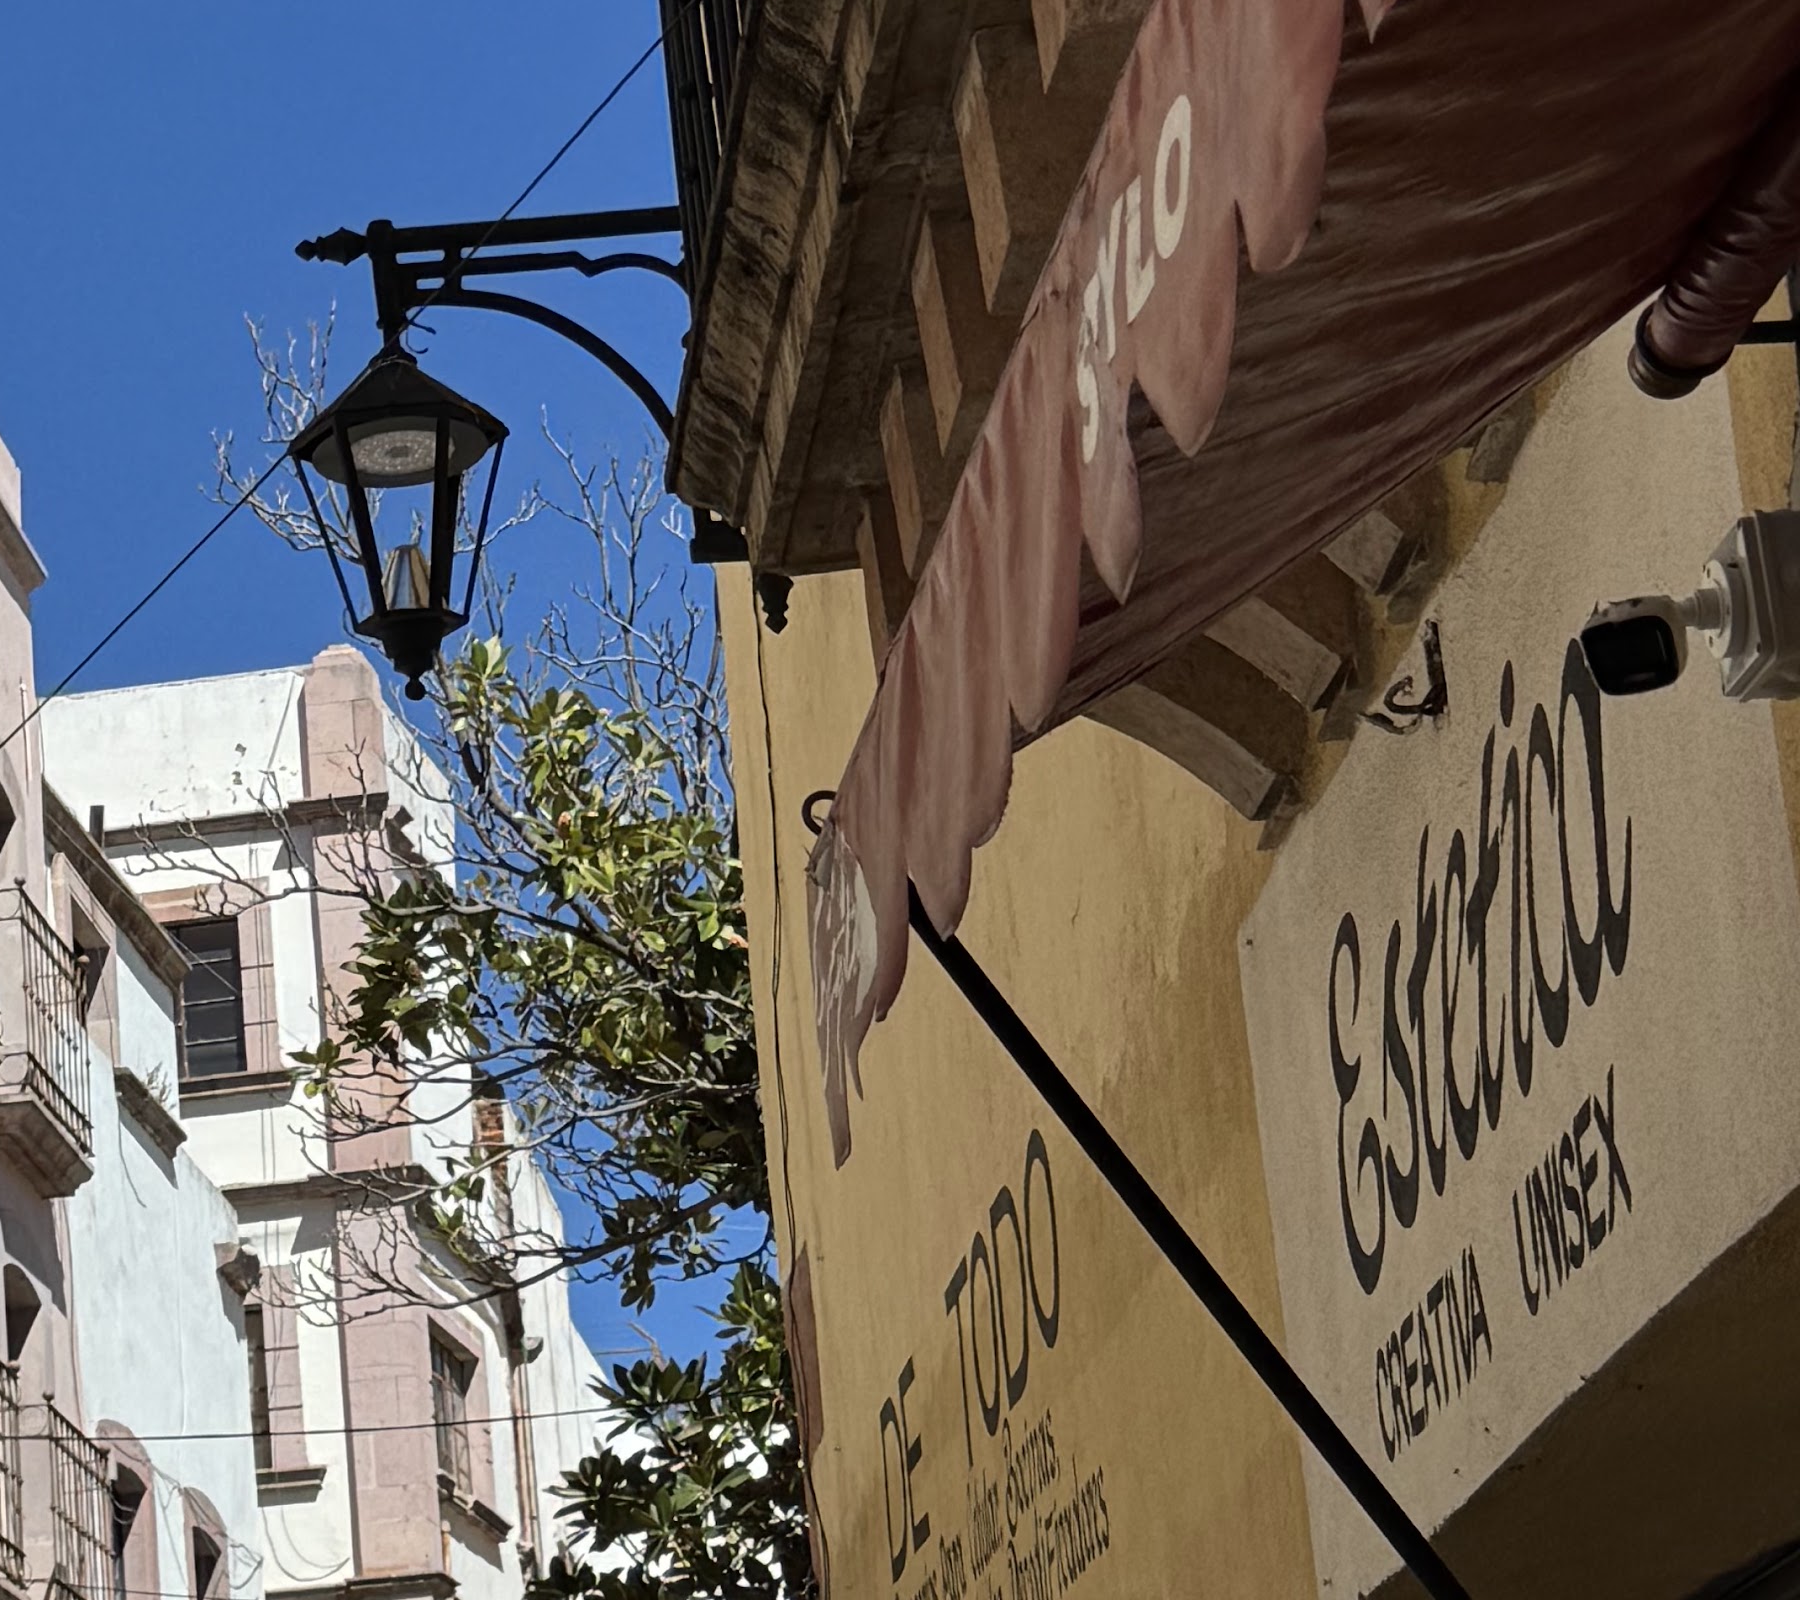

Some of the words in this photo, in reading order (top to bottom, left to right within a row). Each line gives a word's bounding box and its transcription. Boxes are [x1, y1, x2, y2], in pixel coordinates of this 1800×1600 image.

[879, 1357, 931, 1584] DE
[945, 1129, 1059, 1466] TODO
[1374, 1245, 1492, 1460] CREATIVA
[1512, 1063, 1631, 1314] UNISEX
